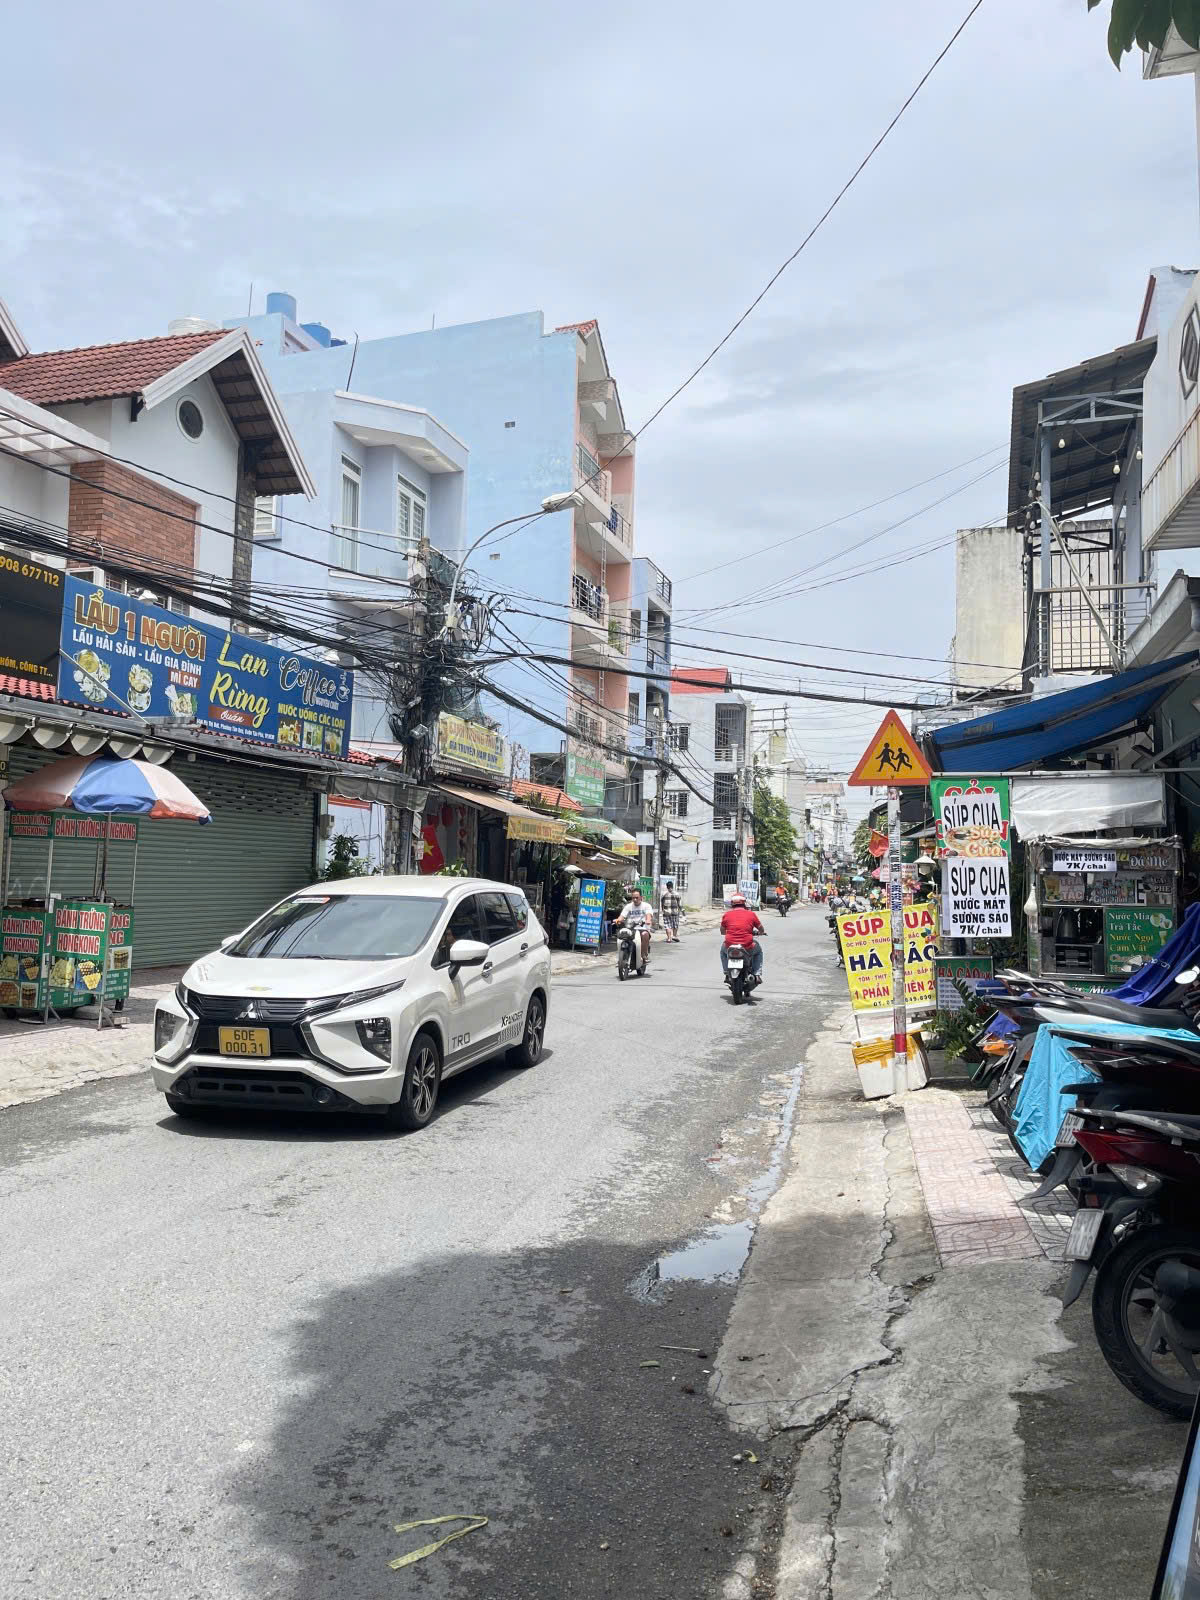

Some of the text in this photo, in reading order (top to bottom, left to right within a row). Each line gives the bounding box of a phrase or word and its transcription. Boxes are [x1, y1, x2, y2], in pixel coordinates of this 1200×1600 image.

[22, 563, 42, 580] 677
[44, 569, 60, 586] 112
[75, 589, 207, 662] LẨU 1 NGƯỜI
[96, 633, 113, 651] HẢI
[116, 640, 136, 658] SẢN
[164, 655, 179, 670] GIA
[181, 660, 202, 676] ĐÌNH
[216, 633, 269, 677] Lan
[183, 675, 199, 688] CAY
[279, 656, 336, 707] Coffee
[209, 670, 270, 728] Rừng
[943, 797, 969, 832] SÚP
[972, 801, 1001, 832] CUA
[55, 815, 137, 840] BÁNH TRỨNG HNGKONG
[585, 882, 600, 897] BỘT
[950, 859, 976, 897] SÚP
[979, 866, 1008, 897] CUA
[953, 896, 1006, 910] NƯỚC MÁT
[2, 914, 21, 934] BÁNH
[55, 905, 105, 931] BÁNH TRỨNG
[842, 910, 935, 938] SÚP UA
[988, 910, 1009, 923] SÁO
[1109, 912, 1131, 921] Nước
[1110, 921, 1142, 931] Trà Tắc
[3, 936, 40, 955] HONGKONG
[57, 932, 100, 956] HONGKONG
[1110, 933, 1131, 941] Nước
[849, 941, 939, 972] HÁ ẢO
[501, 1010, 523, 1027] XPANDER
[233, 1029, 255, 1042] 60E
[225, 1041, 265, 1055] 000.31
